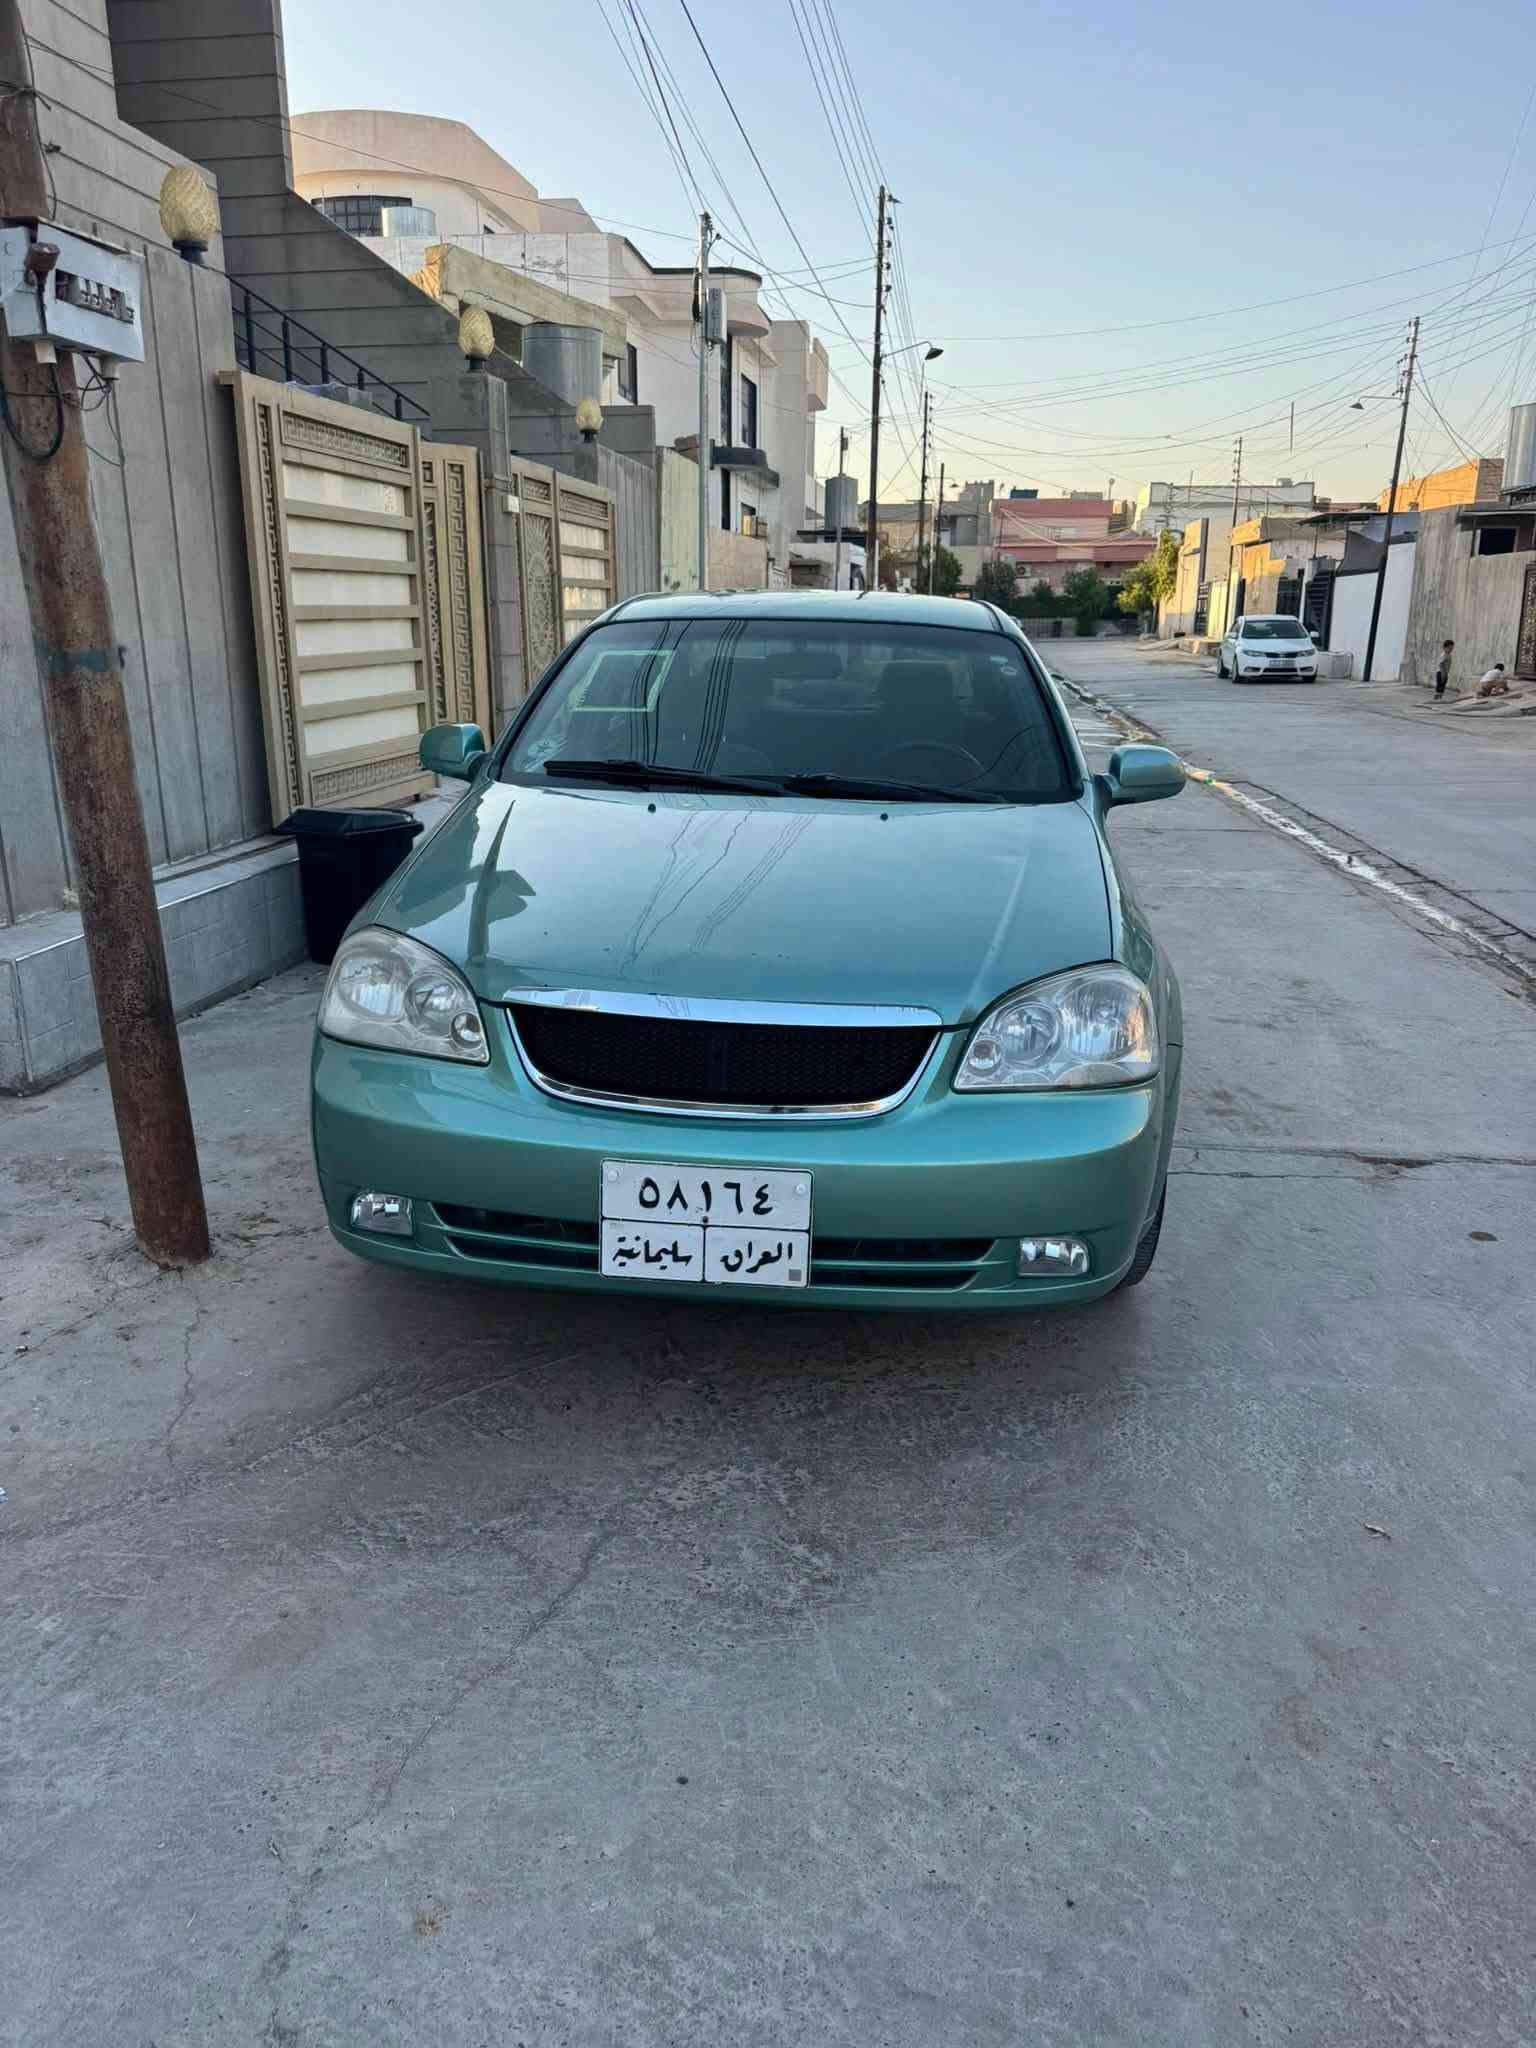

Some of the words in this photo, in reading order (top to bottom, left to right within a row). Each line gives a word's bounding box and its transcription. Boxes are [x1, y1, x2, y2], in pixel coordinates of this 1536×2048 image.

[638, 1177, 773, 1215] ٥٨١٦٤
[612, 1236, 692, 1270] سليمانية
[720, 1241, 793, 1273] العراق
